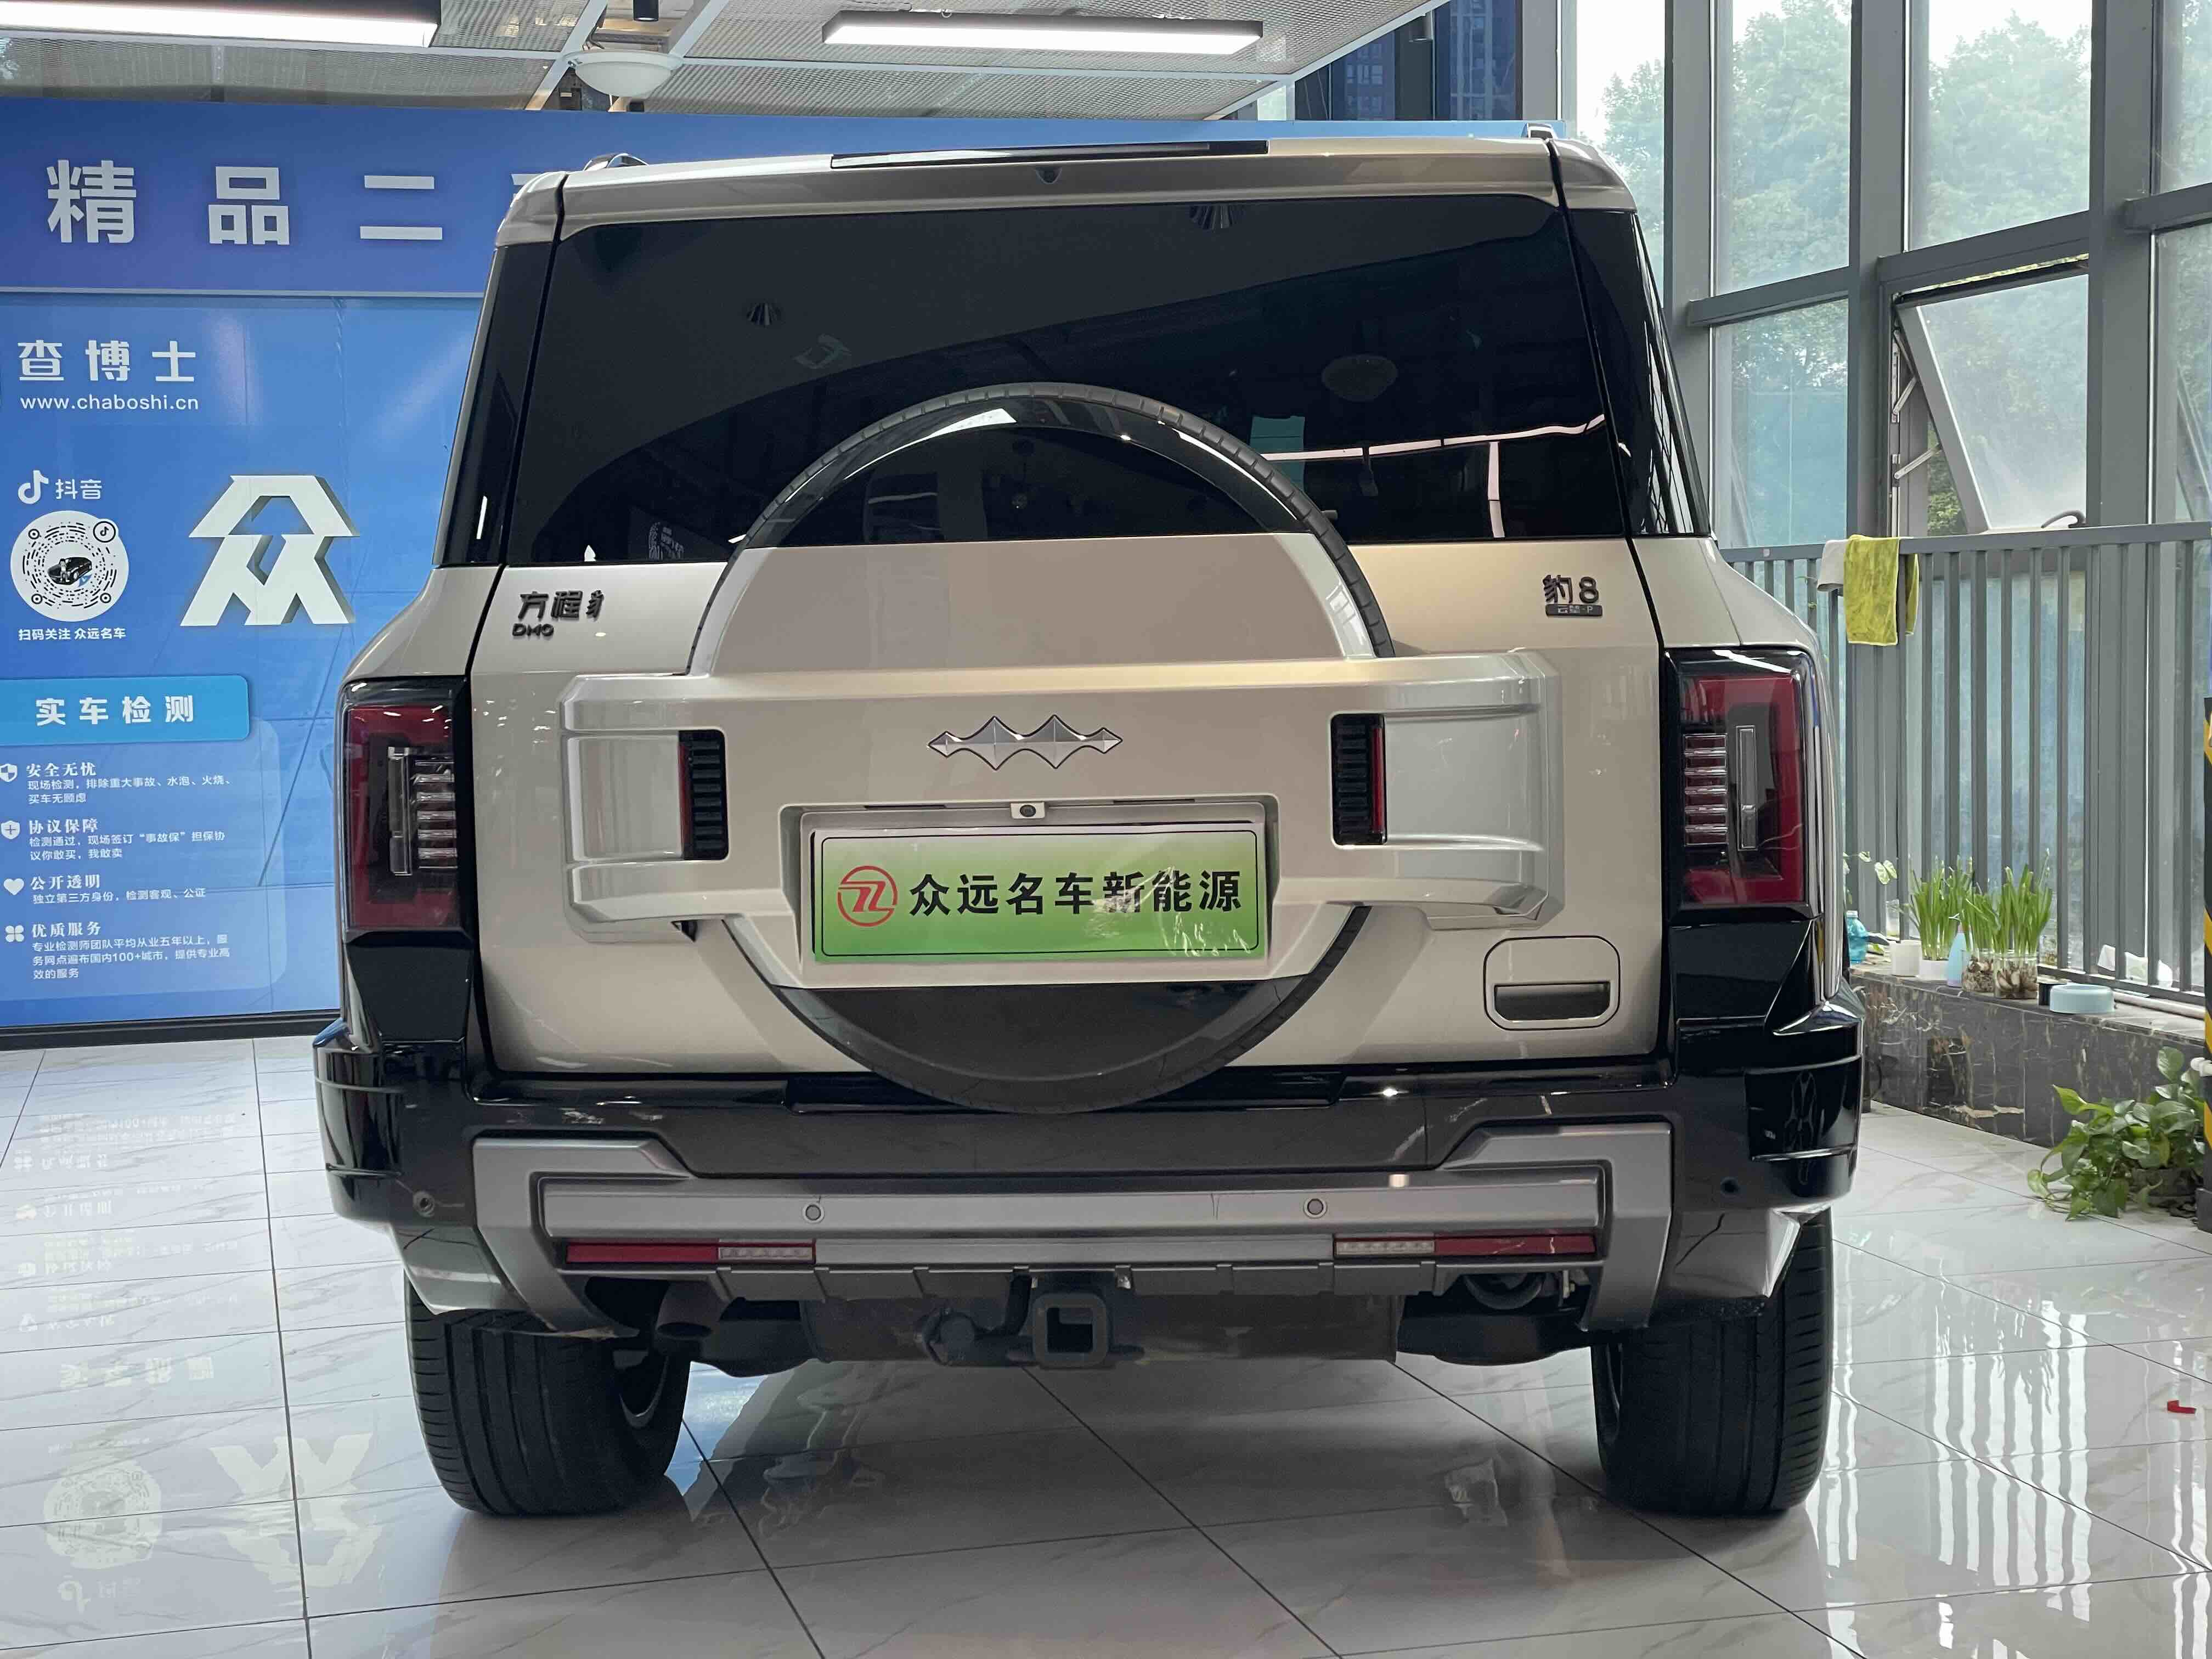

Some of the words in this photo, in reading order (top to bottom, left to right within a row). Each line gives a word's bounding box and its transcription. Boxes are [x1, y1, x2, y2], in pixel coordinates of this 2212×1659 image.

[47, 159, 540, 245] 精品二
[18, 339, 196, 382] 查博士
[20, 394, 199, 410] www.chaboshi.cn
[55, 478, 103, 500] 抖音
[1543, 574, 1599, 603] 豹8
[19, 629, 71, 641] 扫码关注
[74, 628, 126, 640] 众远名车
[35, 695, 194, 727] 实车检测
[26, 762, 97, 777] 安全无忧
[29, 793, 87, 804] 买车无顾虑
[29, 819, 98, 834] 协议保障
[30, 848, 123, 861] 议你敢买，我敢卖
[30, 874, 101, 890] 公开透明
[909, 870, 1242, 916] 众远名车新能源
[31, 921, 101, 938] 优质服务
[33, 968, 80, 979] 效的服务
